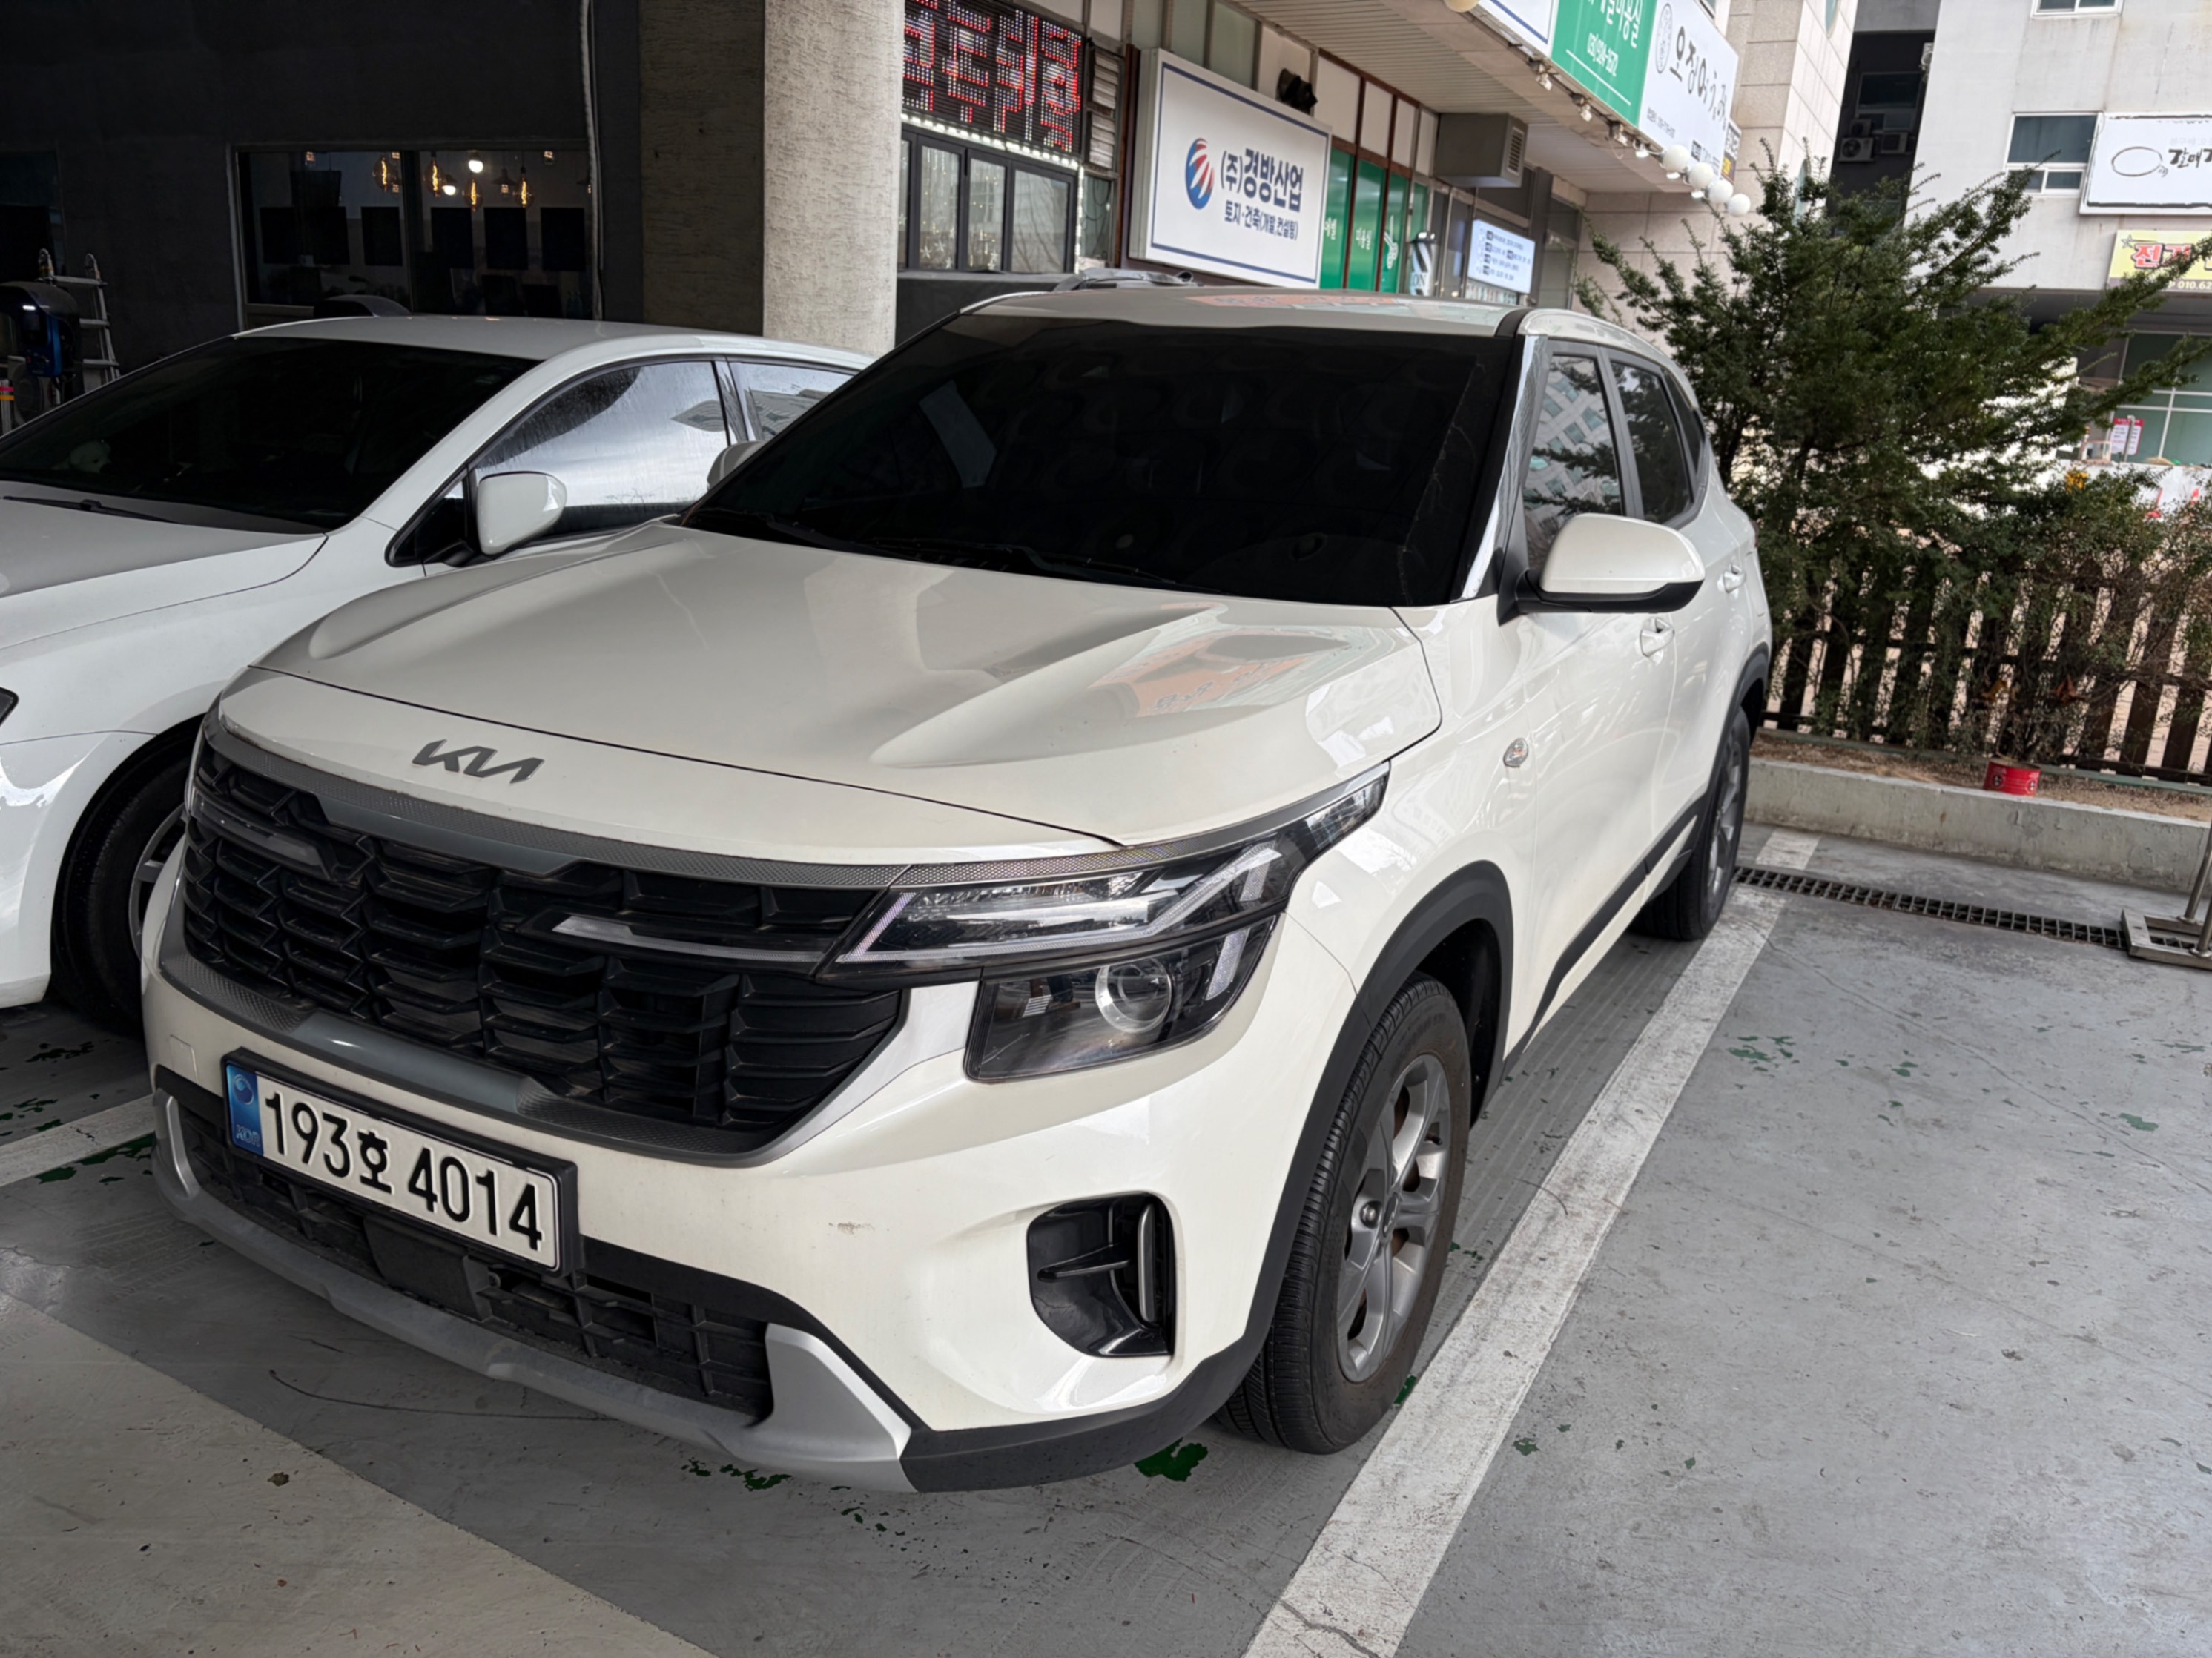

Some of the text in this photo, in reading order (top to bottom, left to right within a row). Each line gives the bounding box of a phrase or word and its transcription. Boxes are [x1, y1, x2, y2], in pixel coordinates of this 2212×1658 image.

[1221, 148, 1304, 213] (주)경방산업
[412, 739, 545, 784] KIA
[235, 1124, 261, 1148] KOR
[265, 1092, 543, 1252] 193호 4014
